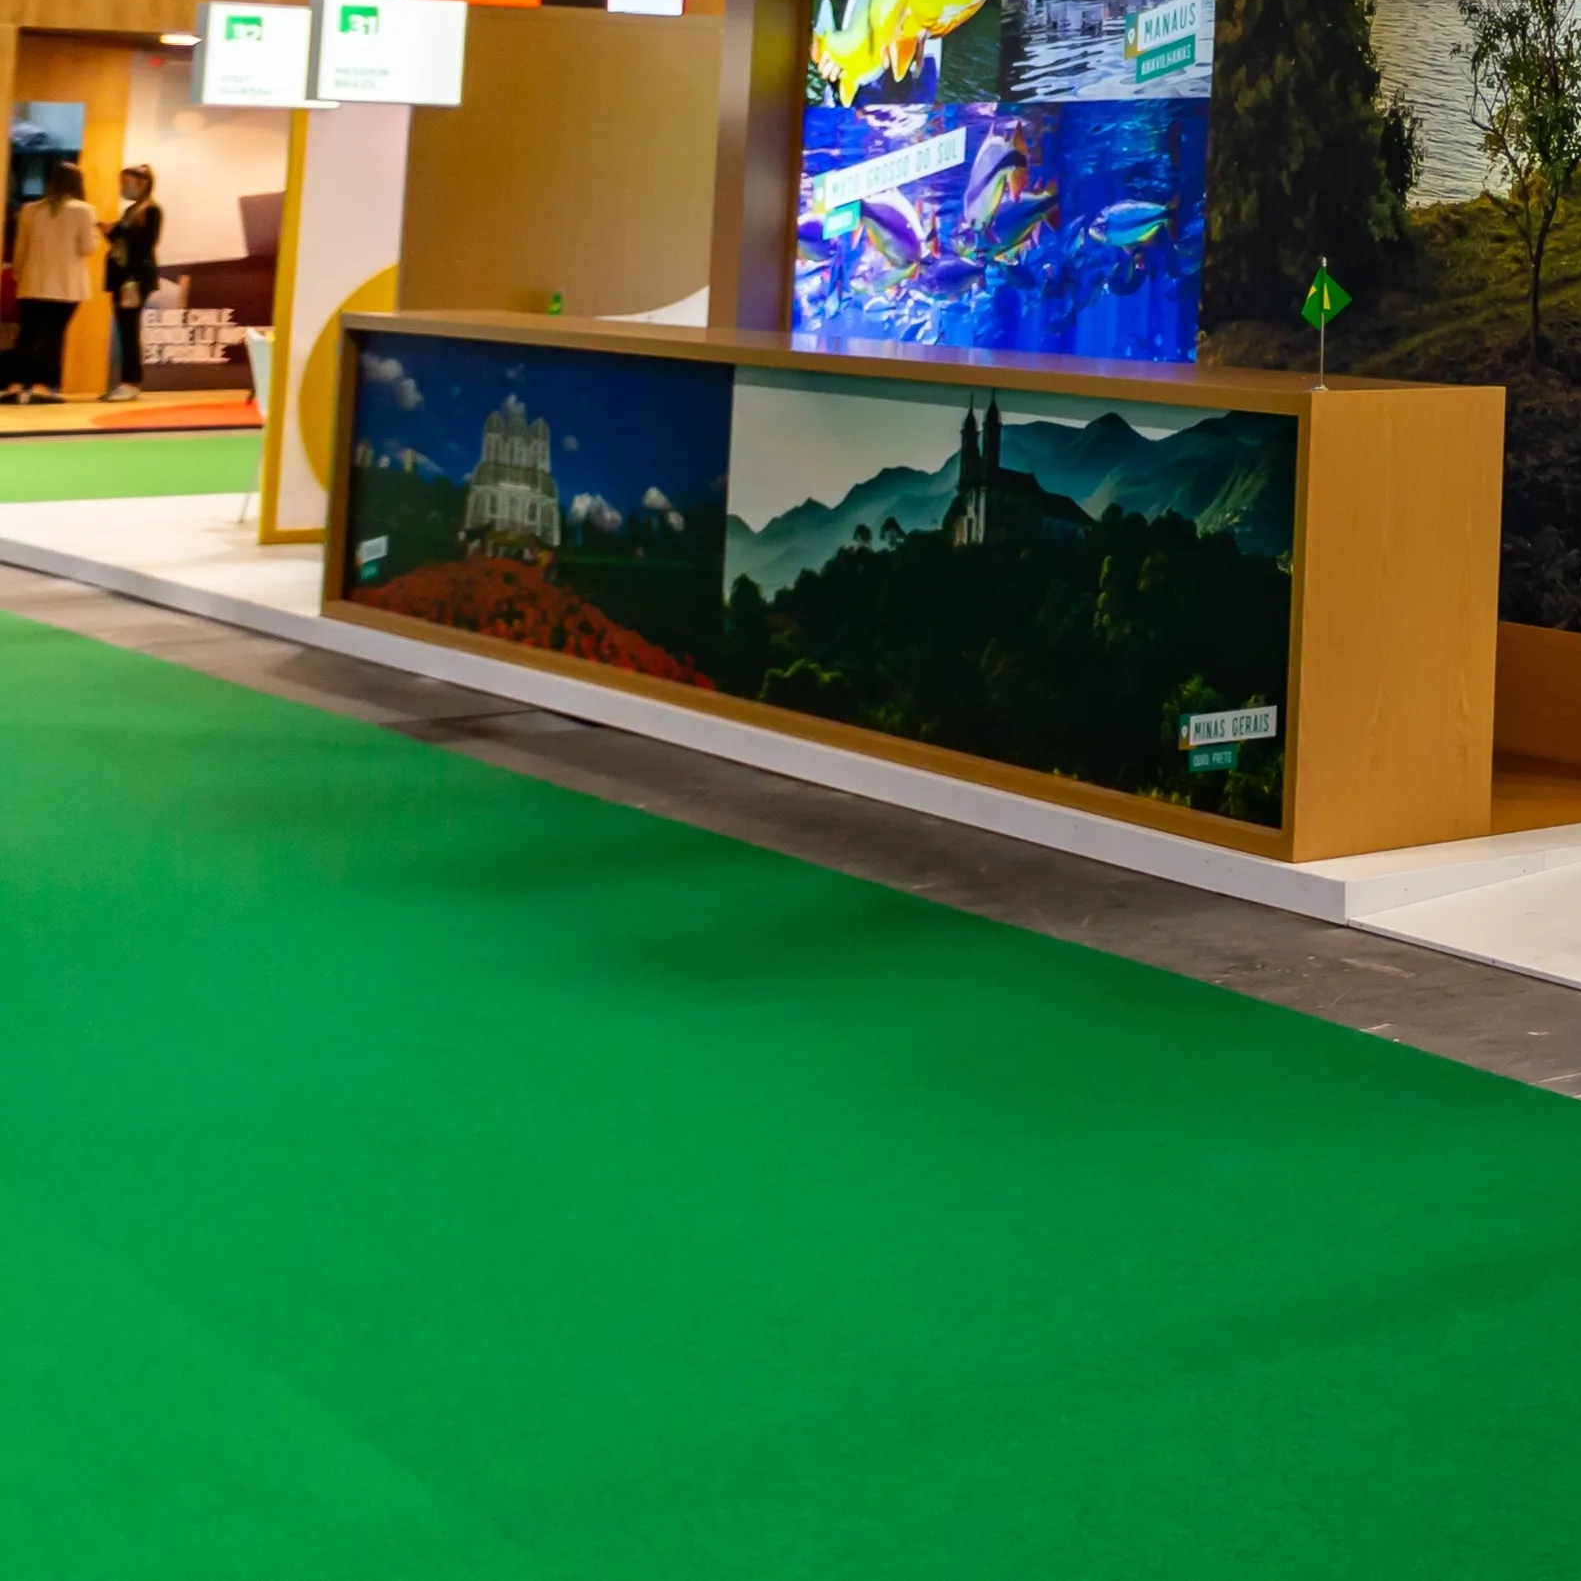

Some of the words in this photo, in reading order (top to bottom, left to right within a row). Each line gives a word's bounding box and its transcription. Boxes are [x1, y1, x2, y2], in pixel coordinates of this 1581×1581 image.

[1144, 2, 1196, 44] MANAUS
[937, 137, 958, 165] SUL
[1194, 719, 1226, 740] MINAS
[1231, 713, 1270, 737] GERAIS
